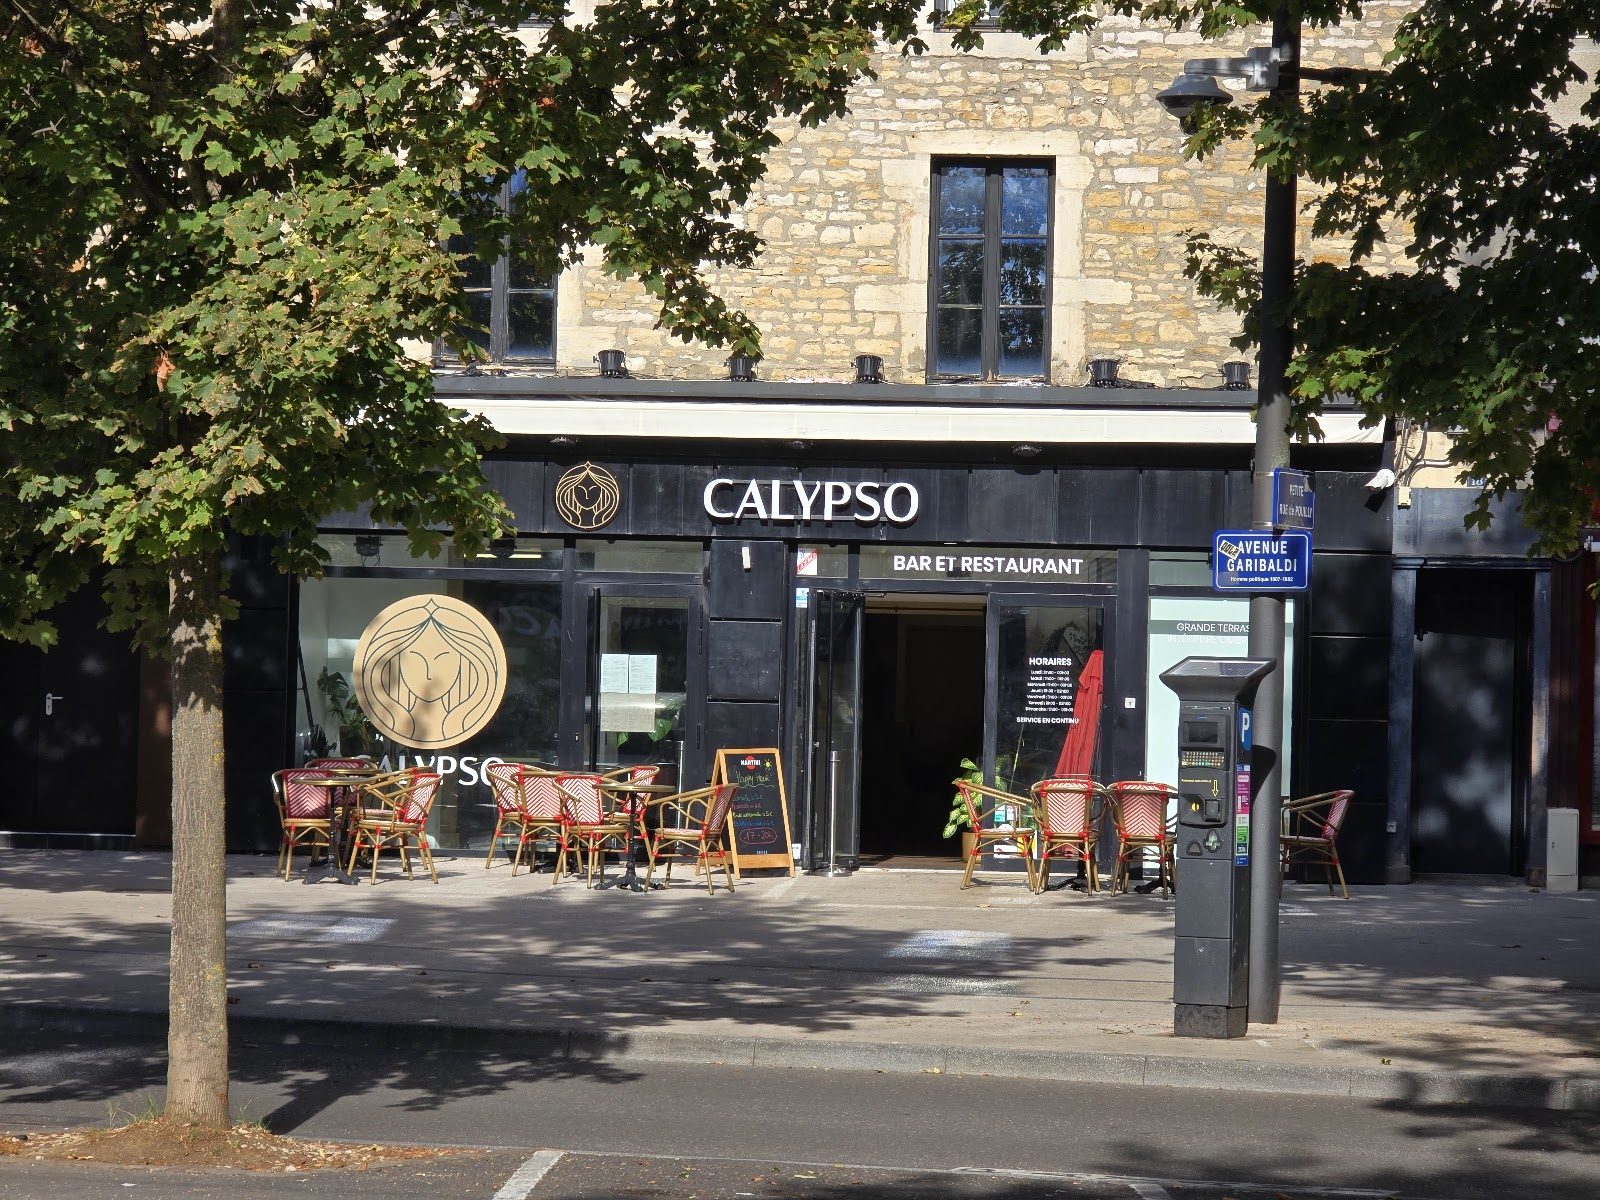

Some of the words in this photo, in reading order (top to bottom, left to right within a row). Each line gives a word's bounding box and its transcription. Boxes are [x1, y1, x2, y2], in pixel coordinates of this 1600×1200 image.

[1289, 483, 1304, 497] PETITE
[703, 478, 919, 523] CALYPSO
[1238, 540, 1288, 555] AVENUE
[893, 555, 931, 571] BAR
[935, 556, 955, 572] ET
[961, 556, 1083, 575] RESTAURANT
[1227, 558, 1297, 572] GARIBALDI
[1176, 622, 1216, 632] GRANDE
[1218, 623, 1249, 633] TERRAS
[1028, 657, 1072, 666] HORAIRES
[1016, 716, 1042, 724] SERVICE
[355, 754, 505, 786] ALYPSO
